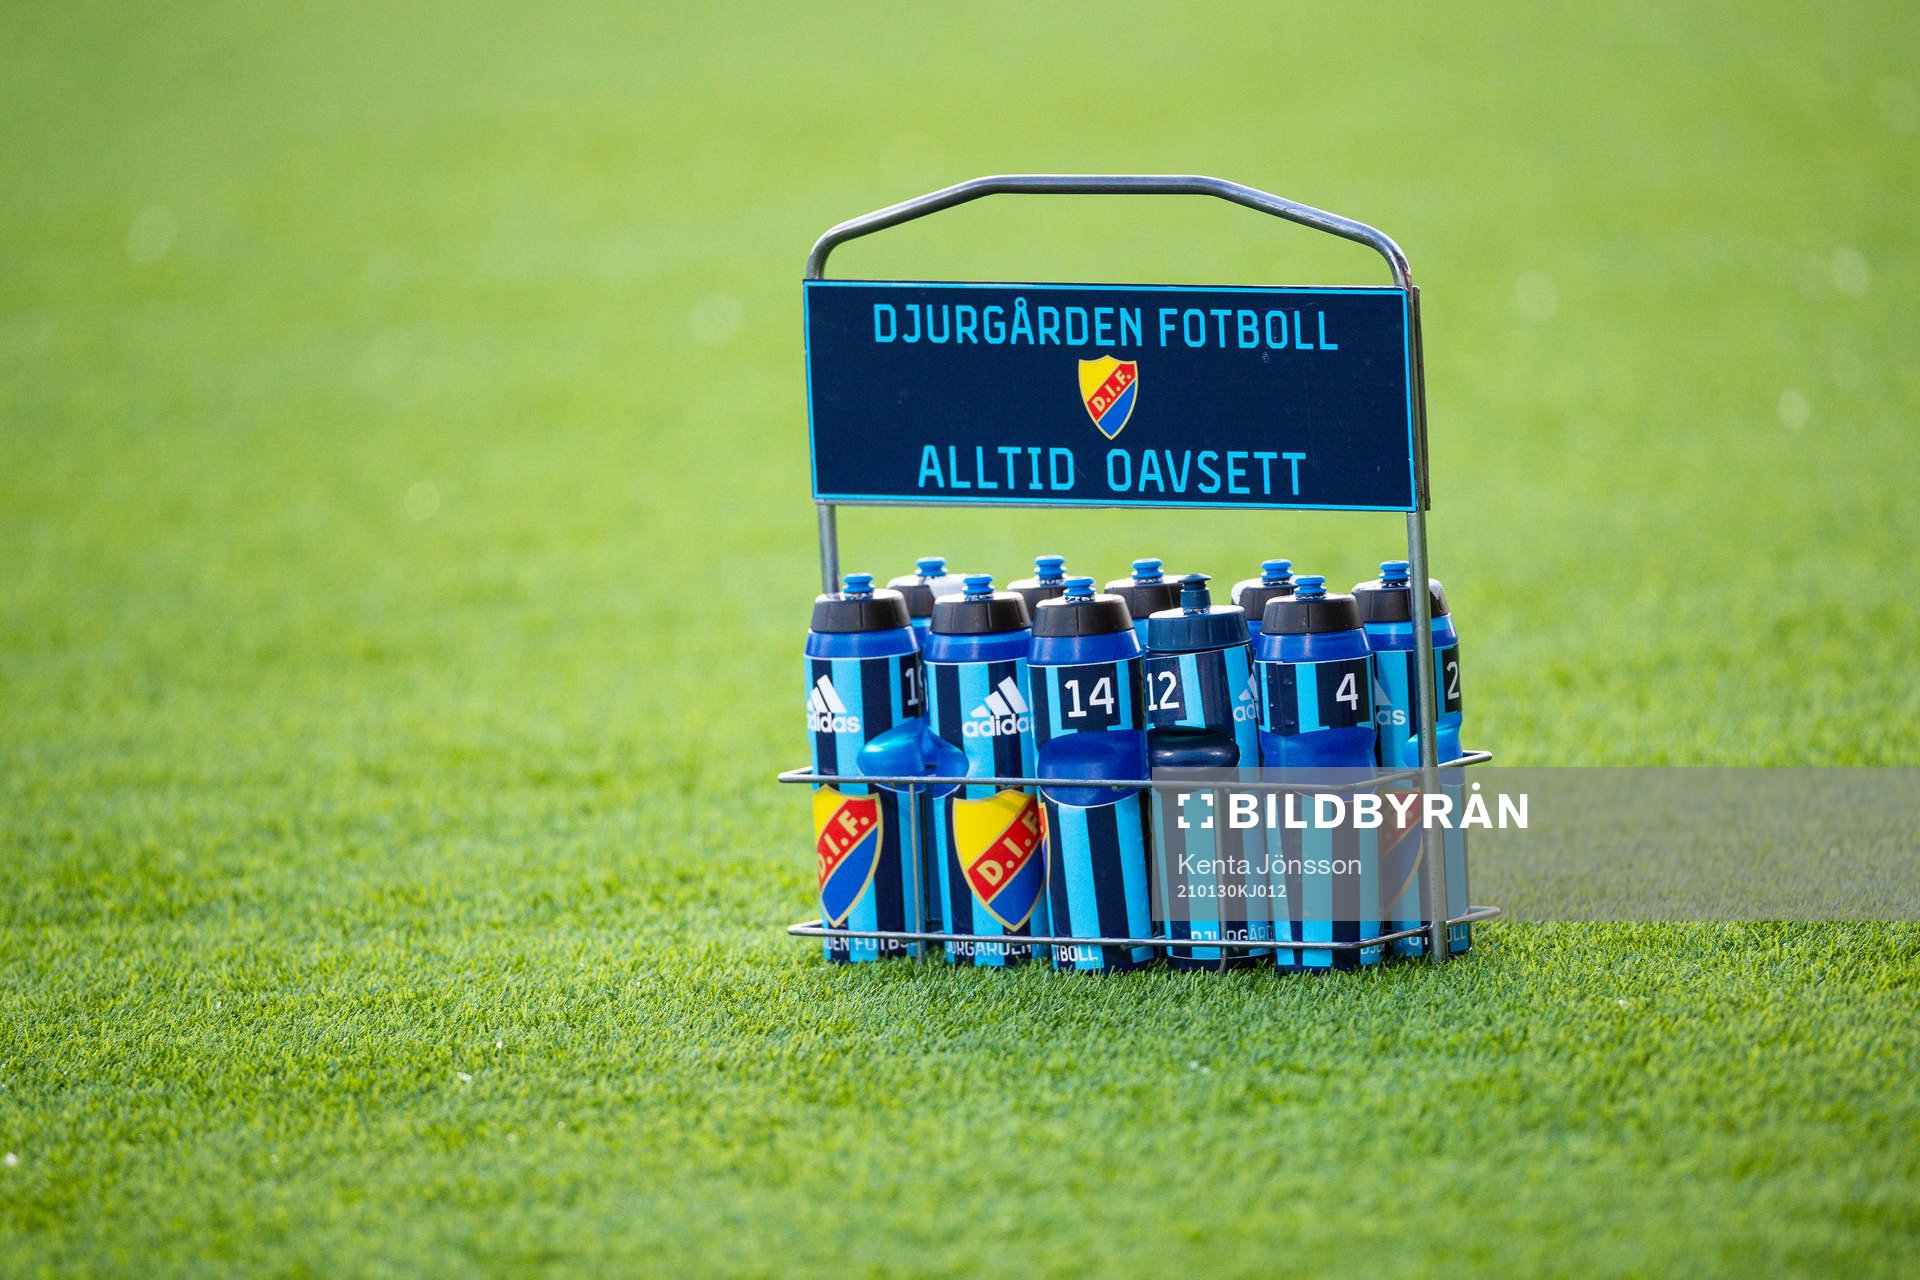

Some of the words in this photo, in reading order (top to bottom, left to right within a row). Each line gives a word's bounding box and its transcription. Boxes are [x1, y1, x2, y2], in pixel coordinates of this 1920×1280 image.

[873, 297, 1145, 347] DJURGÅRDEN
[1159, 308, 1339, 351] FOTBOLL
[1092, 370, 1131, 412] D.I.F.
[918, 445, 1076, 491] ALLTID
[1107, 448, 1307, 496] OAVSETT
[1064, 676, 1115, 718] 14
[1146, 670, 1180, 712] 12
[1336, 672, 1359, 711] 4
[962, 713, 1030, 738] adida
[976, 810, 1039, 887] D.I.F
